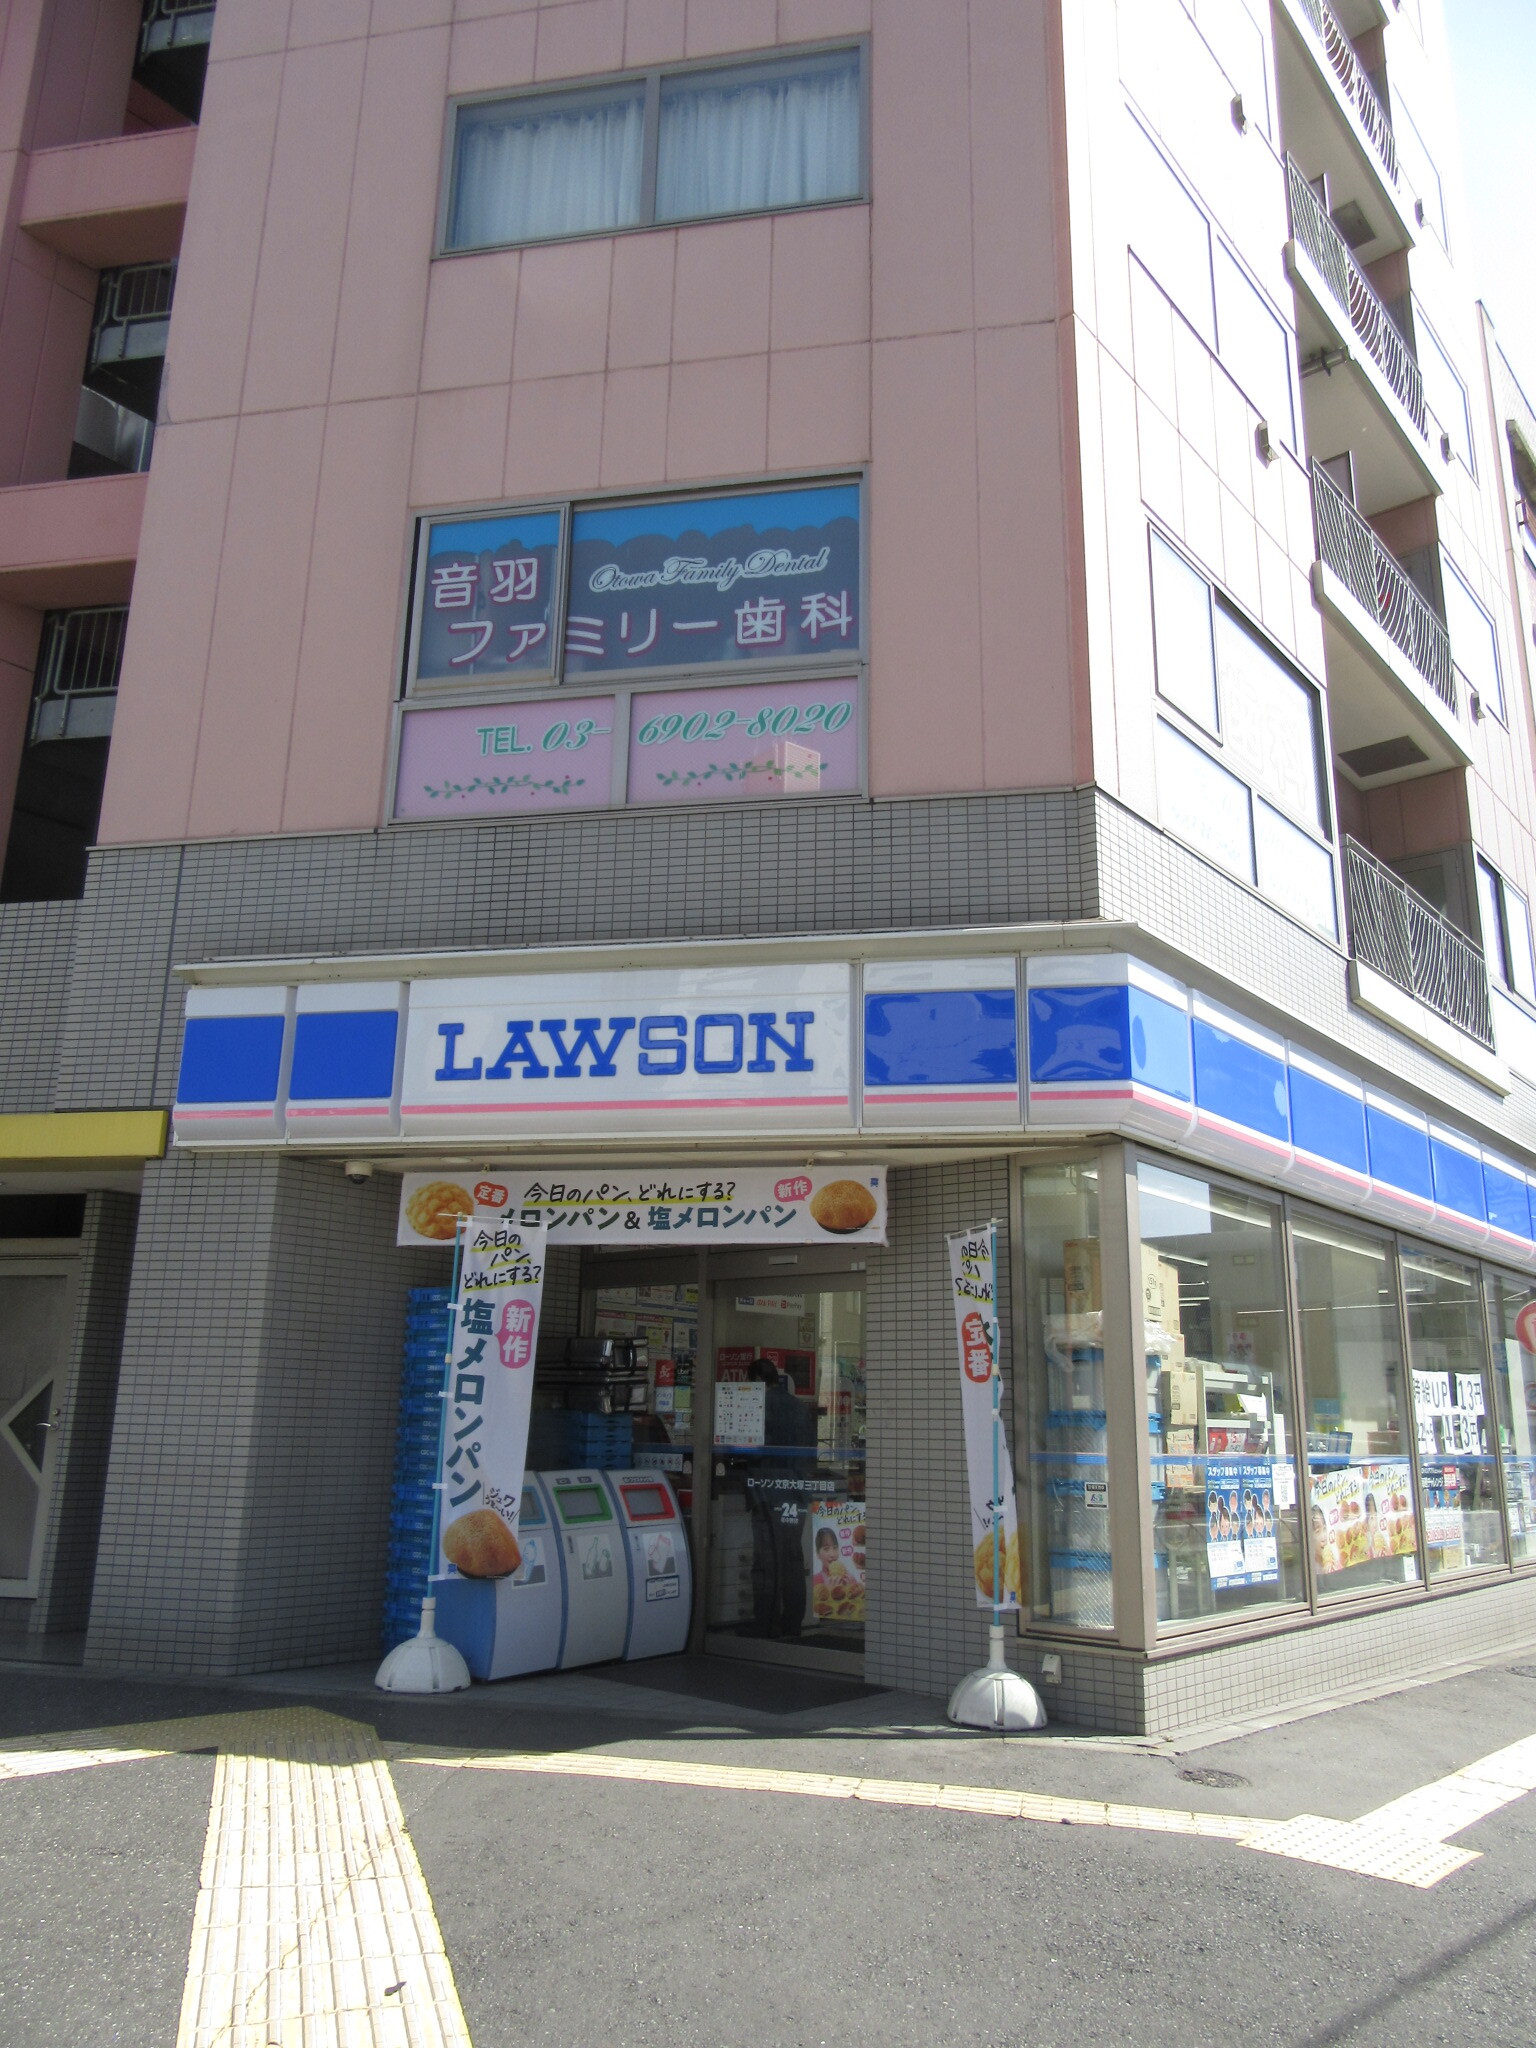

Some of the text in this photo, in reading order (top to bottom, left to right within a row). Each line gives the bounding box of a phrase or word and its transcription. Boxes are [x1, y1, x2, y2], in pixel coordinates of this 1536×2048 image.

[431, 557, 538, 609] 音羽
[589, 547, 829, 592] Otowa Family Dental
[449, 590, 854, 664] ファミリー歯科
[476, 726, 532, 756] TEL.
[636, 701, 853, 746] 6902-8020
[435, 1011, 815, 1082] LAWSON
[476, 1184, 505, 1204] 定番
[777, 1180, 808, 1198] 新作
[472, 1229, 521, 1251] 今日の
[502, 1305, 532, 1365] 新作
[719, 1352, 753, 1361] ローソン銀行
[721, 1368, 749, 1382] ATM
[446, 1297, 496, 1508] 塩メロンパン
[781, 1502, 798, 1518] 24
